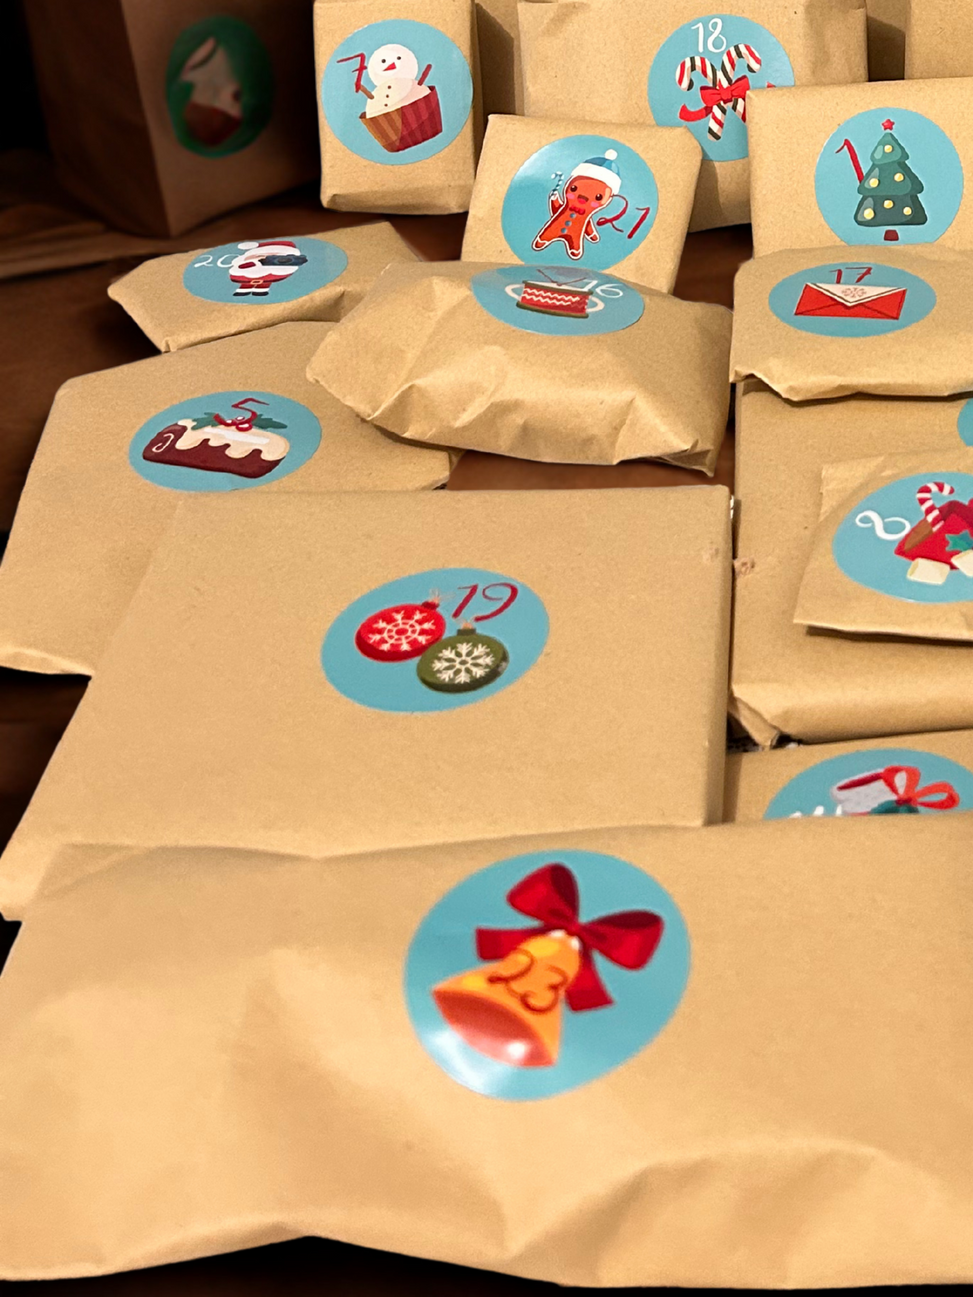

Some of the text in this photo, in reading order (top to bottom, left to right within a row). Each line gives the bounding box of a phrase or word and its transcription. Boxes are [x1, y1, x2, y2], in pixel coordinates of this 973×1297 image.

[691, 17, 727, 53] 18
[336, 52, 367, 93] 7
[835, 138, 865, 183] 1
[596, 193, 650, 239] 21
[582, 280, 623, 298] 16
[829, 266, 872, 284] 17
[213, 398, 269, 424] 5
[855, 510, 911, 541] 8
[451, 582, 518, 622] 19
[488, 948, 565, 1013] 23
